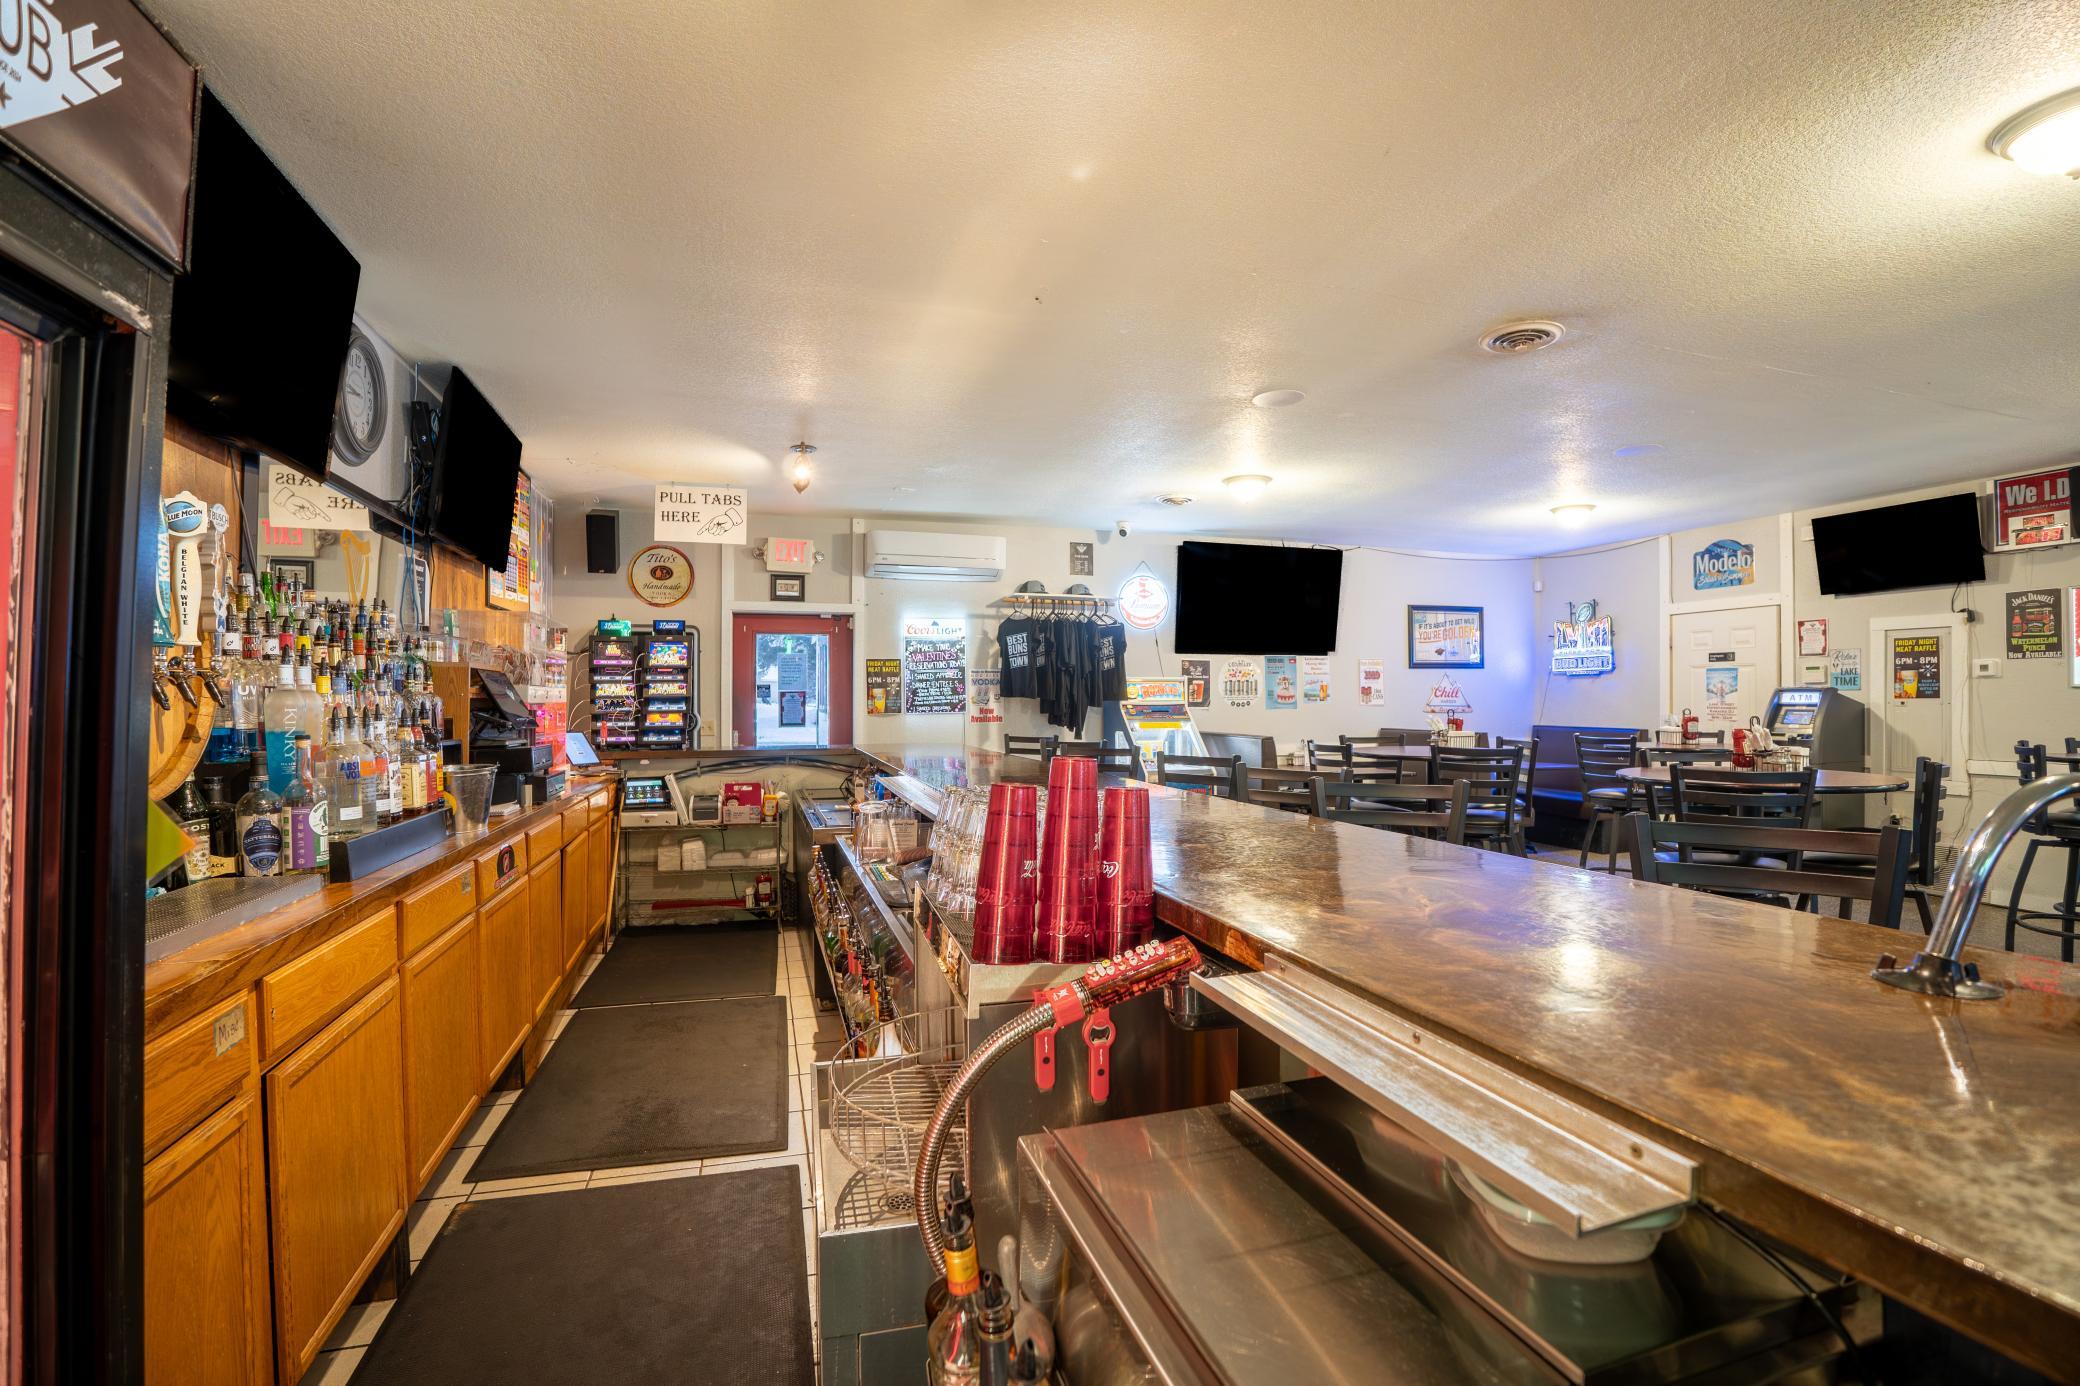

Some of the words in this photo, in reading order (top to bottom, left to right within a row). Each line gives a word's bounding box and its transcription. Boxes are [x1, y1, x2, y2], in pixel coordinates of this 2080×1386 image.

[660, 492, 696, 504] PULL
[701, 493, 742, 506] TABS
[2005, 484, 2037, 507] We
[168, 512, 179, 522] LUE
[181, 508, 203, 519] MOON
[211, 511, 229, 525] BUSCH
[661, 511, 700, 523] HERE
[775, 541, 806, 563] EXIT
[158, 533, 170, 583] KONA
[646, 553, 678, 563] Tito's
[1696, 550, 1751, 576] Modelo
[180, 548, 188, 591] BELGIAN
[642, 582, 681, 591] Handmade
[2011, 595, 2028, 607] JACK
[2027, 593, 2055, 605] DANIEL'S
[180, 594, 189, 626] WHITE
[937, 627, 962, 635] LIGHT
[1418, 628, 1441, 640] YOU'RE
[1442, 625, 1475, 640] GOLDEN
[1006, 633, 1028, 644] BEST
[2011, 637, 2058, 645] WATERMELON
[1008, 643, 1028, 654] BUNS
[1920, 656, 1938, 664] 8PM
[2025, 651, 2062, 659] AVAILABLE
[1009, 656, 1028, 669] TOWN
[1840, 667, 1859, 676] LAKE
[1833, 676, 1859, 687] TIME
[237, 685, 258, 696] UV
[1434, 687, 1460, 698] Chill
[1789, 694, 1813, 703] ATM
[970, 715, 1003, 723] Available
[283, 708, 297, 761] KINKY
